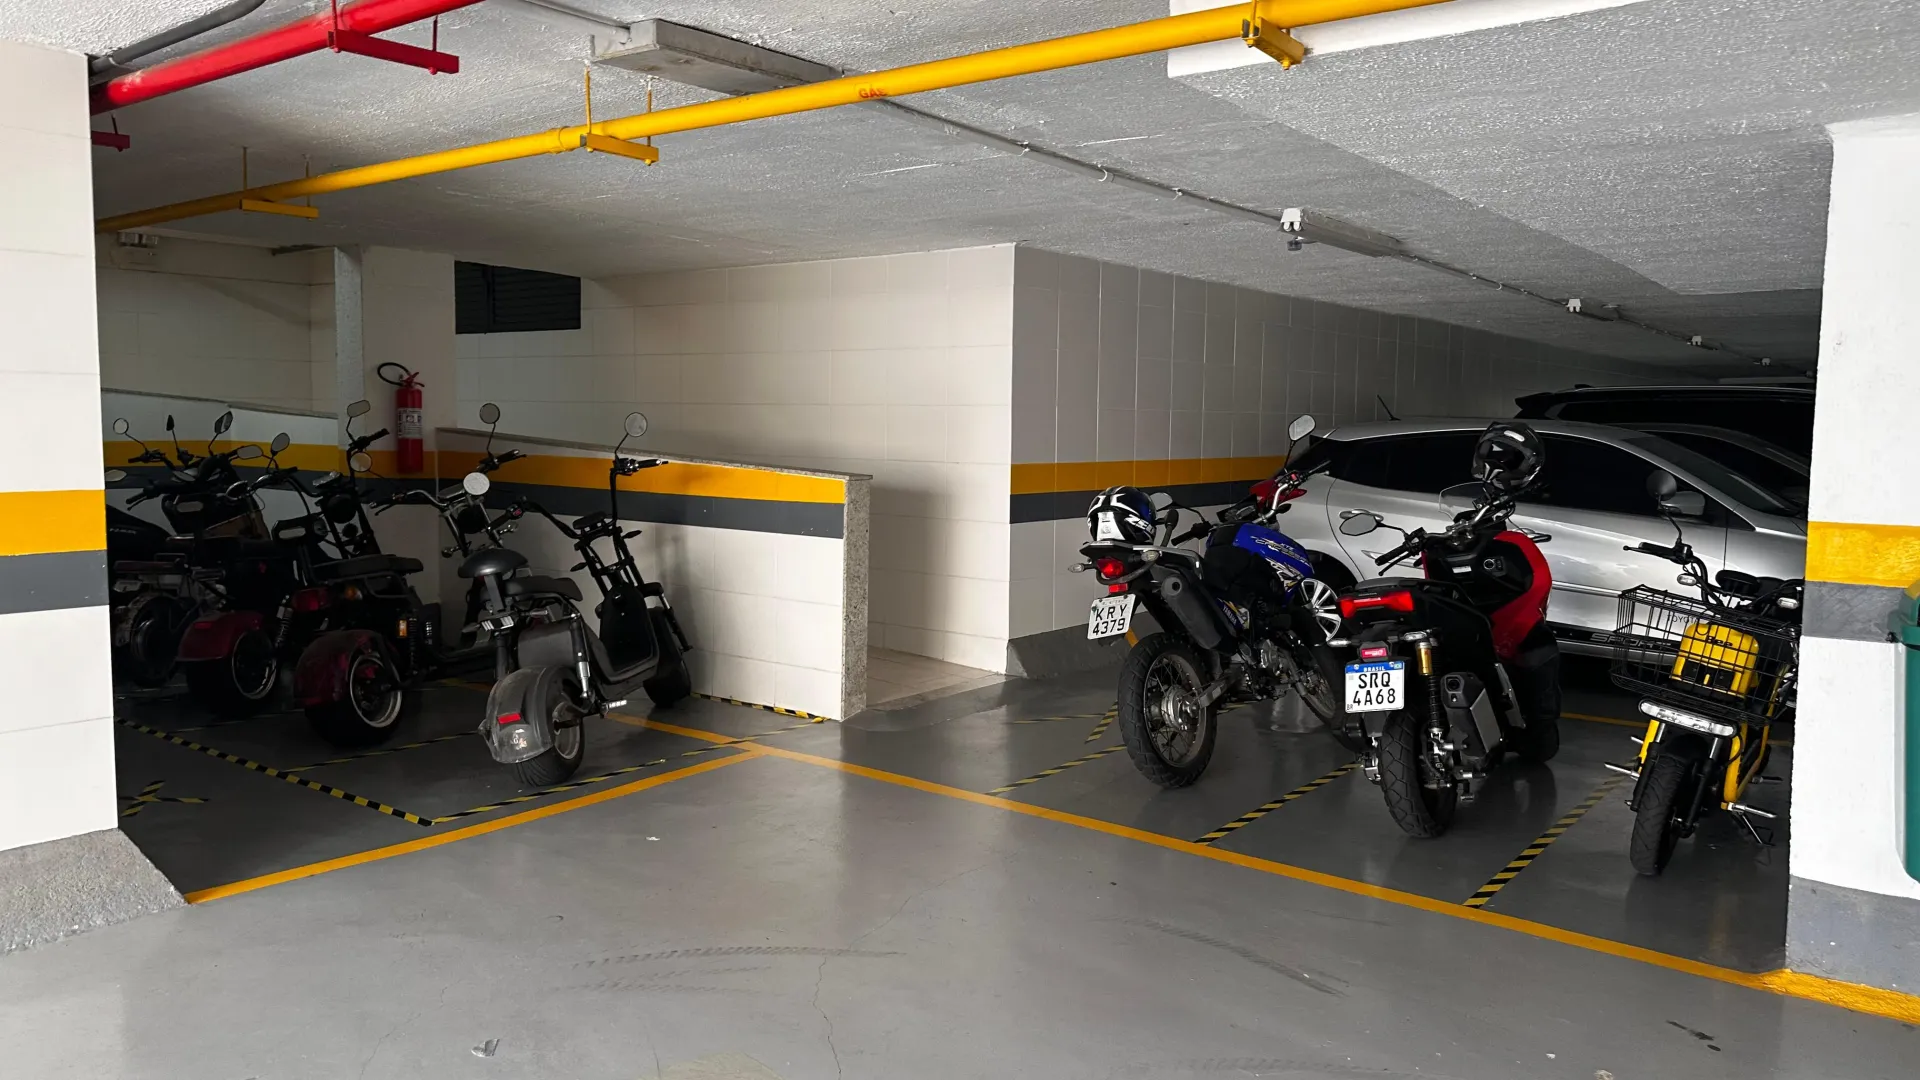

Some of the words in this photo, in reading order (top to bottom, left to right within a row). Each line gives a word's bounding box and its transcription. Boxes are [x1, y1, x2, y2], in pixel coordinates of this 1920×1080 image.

[1095, 604, 1128, 621] KRY
[1092, 617, 1126, 636] 4379
[1358, 672, 1391, 689] SRQ
[1353, 688, 1396, 706] 4A68
